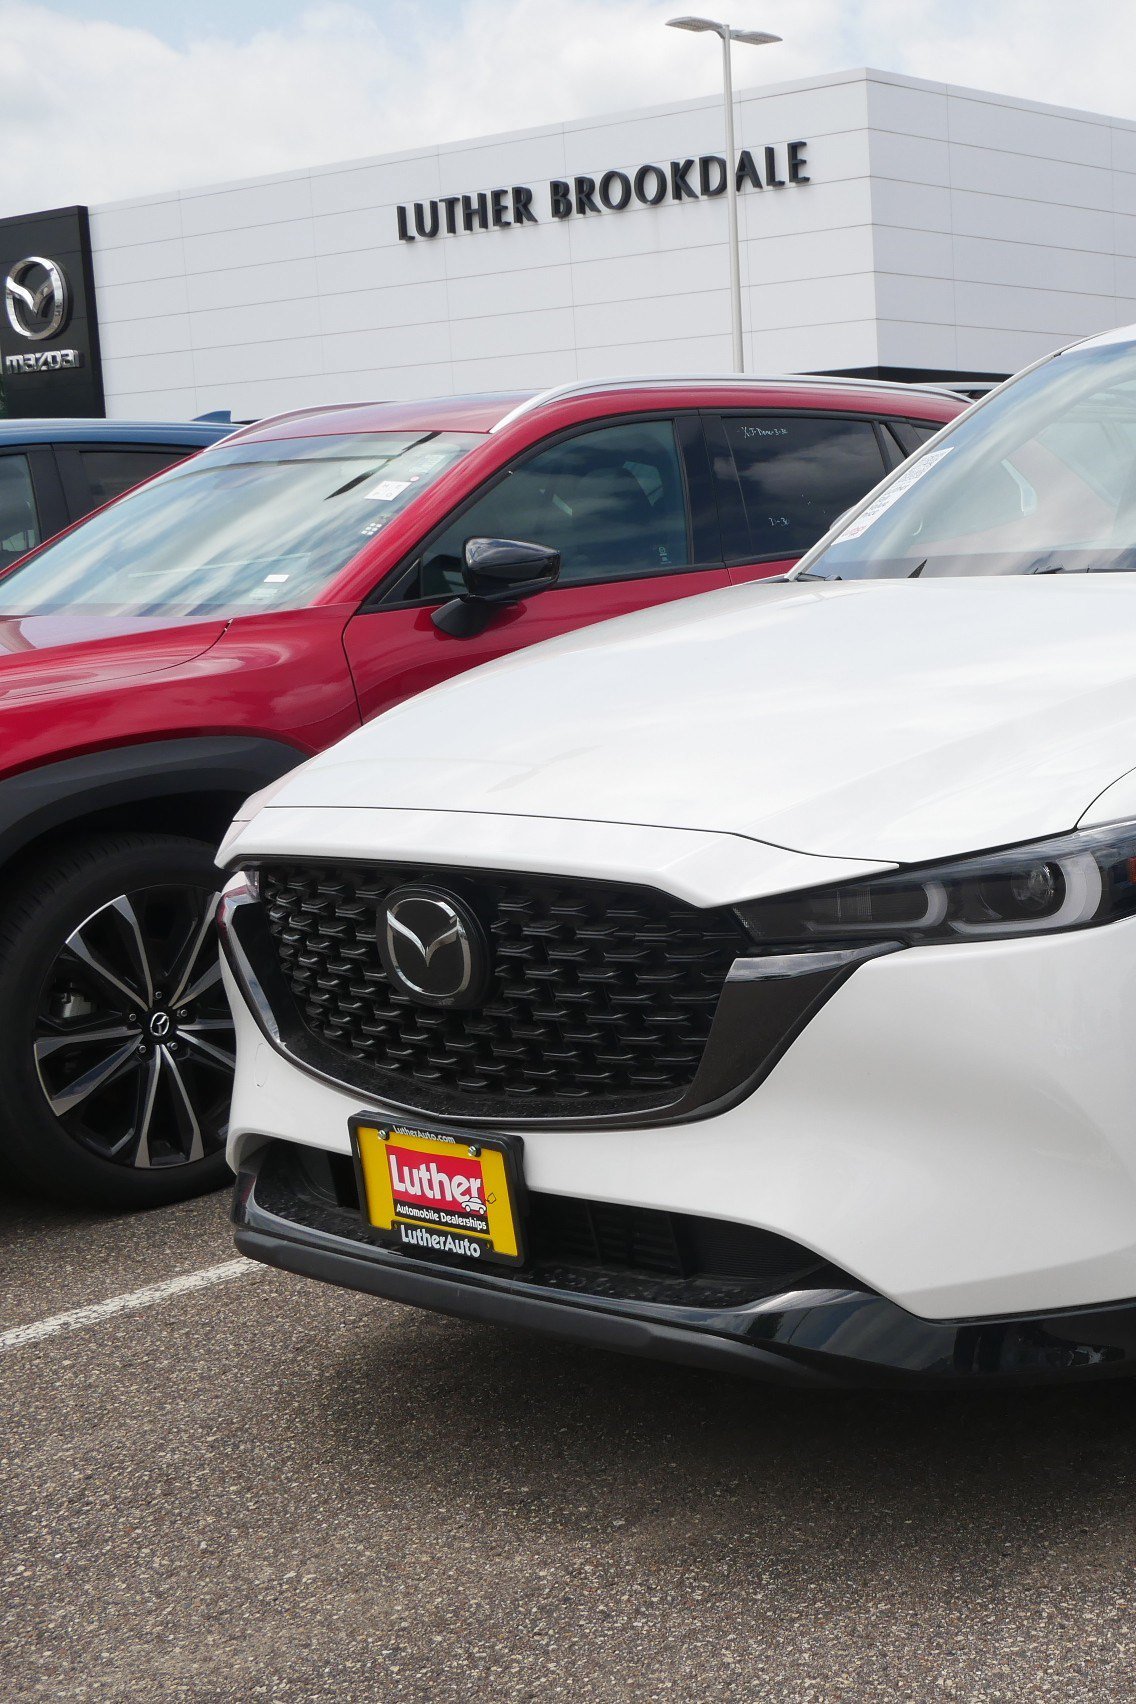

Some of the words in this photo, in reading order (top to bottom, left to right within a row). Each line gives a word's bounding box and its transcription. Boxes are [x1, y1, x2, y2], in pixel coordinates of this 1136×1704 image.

[396, 186, 537, 241] LUTHER
[549, 141, 810, 219] BROOKDALE
[6, 350, 80, 374] mazda
[393, 1125, 456, 1144] LutherAuto.com
[389, 1154, 482, 1203] Luther
[396, 1203, 439, 1221] Automobile
[441, 1212, 487, 1230] Dealerships
[400, 1224, 481, 1258] LutherAuto
